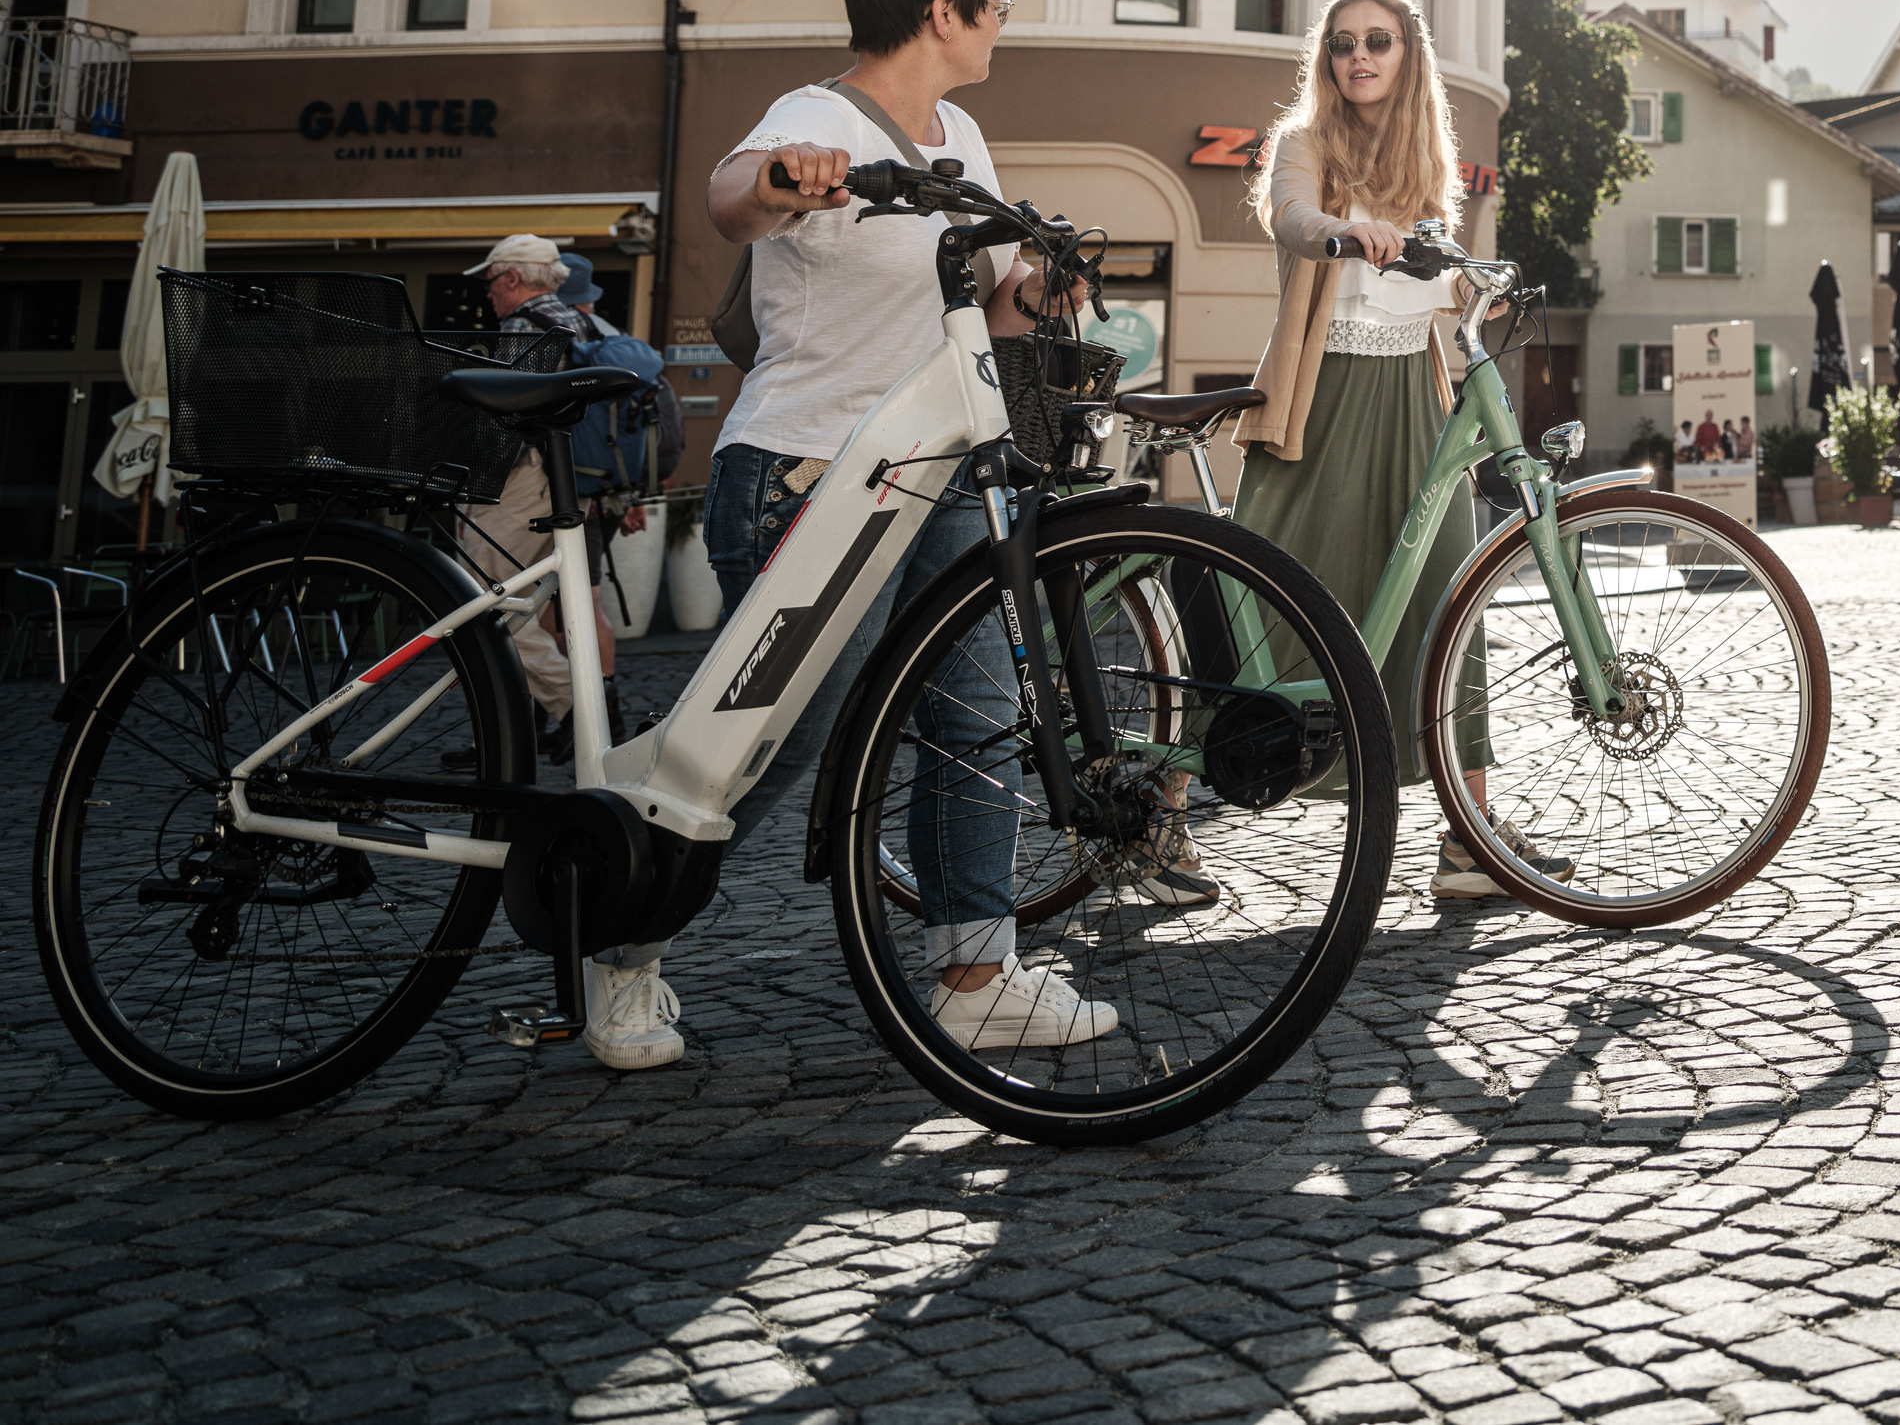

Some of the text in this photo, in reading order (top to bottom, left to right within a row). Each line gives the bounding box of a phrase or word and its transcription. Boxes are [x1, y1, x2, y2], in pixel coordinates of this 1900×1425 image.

[300, 99, 498, 140] GANTER
[335, 145, 462, 160] CAFÉ BAR DELI
[571, 379, 599, 387] WAVE
[877, 466, 902, 505] WAVE
[1401, 479, 1442, 549] Cube
[1006, 605, 1023, 646] SUNTOUR
[729, 613, 787, 706] VIPER
[334, 683, 354, 701] BOSCH
[1128, 1108, 1152, 1119] ROAD
